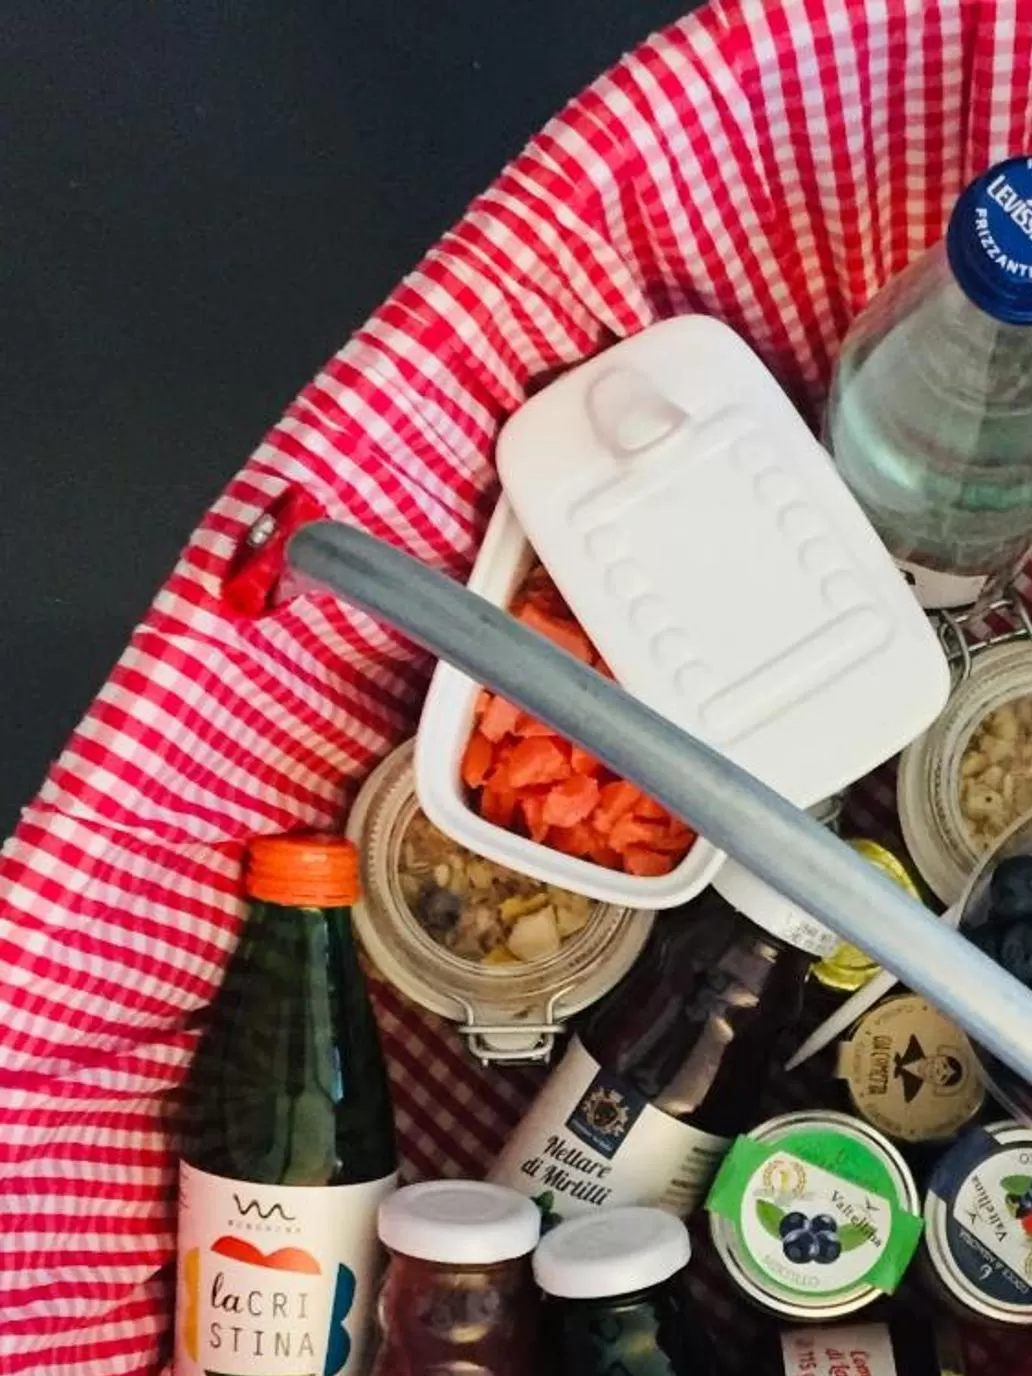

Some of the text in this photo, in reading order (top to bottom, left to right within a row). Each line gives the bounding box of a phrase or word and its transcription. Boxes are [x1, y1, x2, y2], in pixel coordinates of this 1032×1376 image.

[543, 1134, 613, 1179] Nettare
[520, 1156, 613, 1207] di Mirtilli
[208, 1321, 316, 1358] STINA
[797, 1351, 818, 1372] 115
